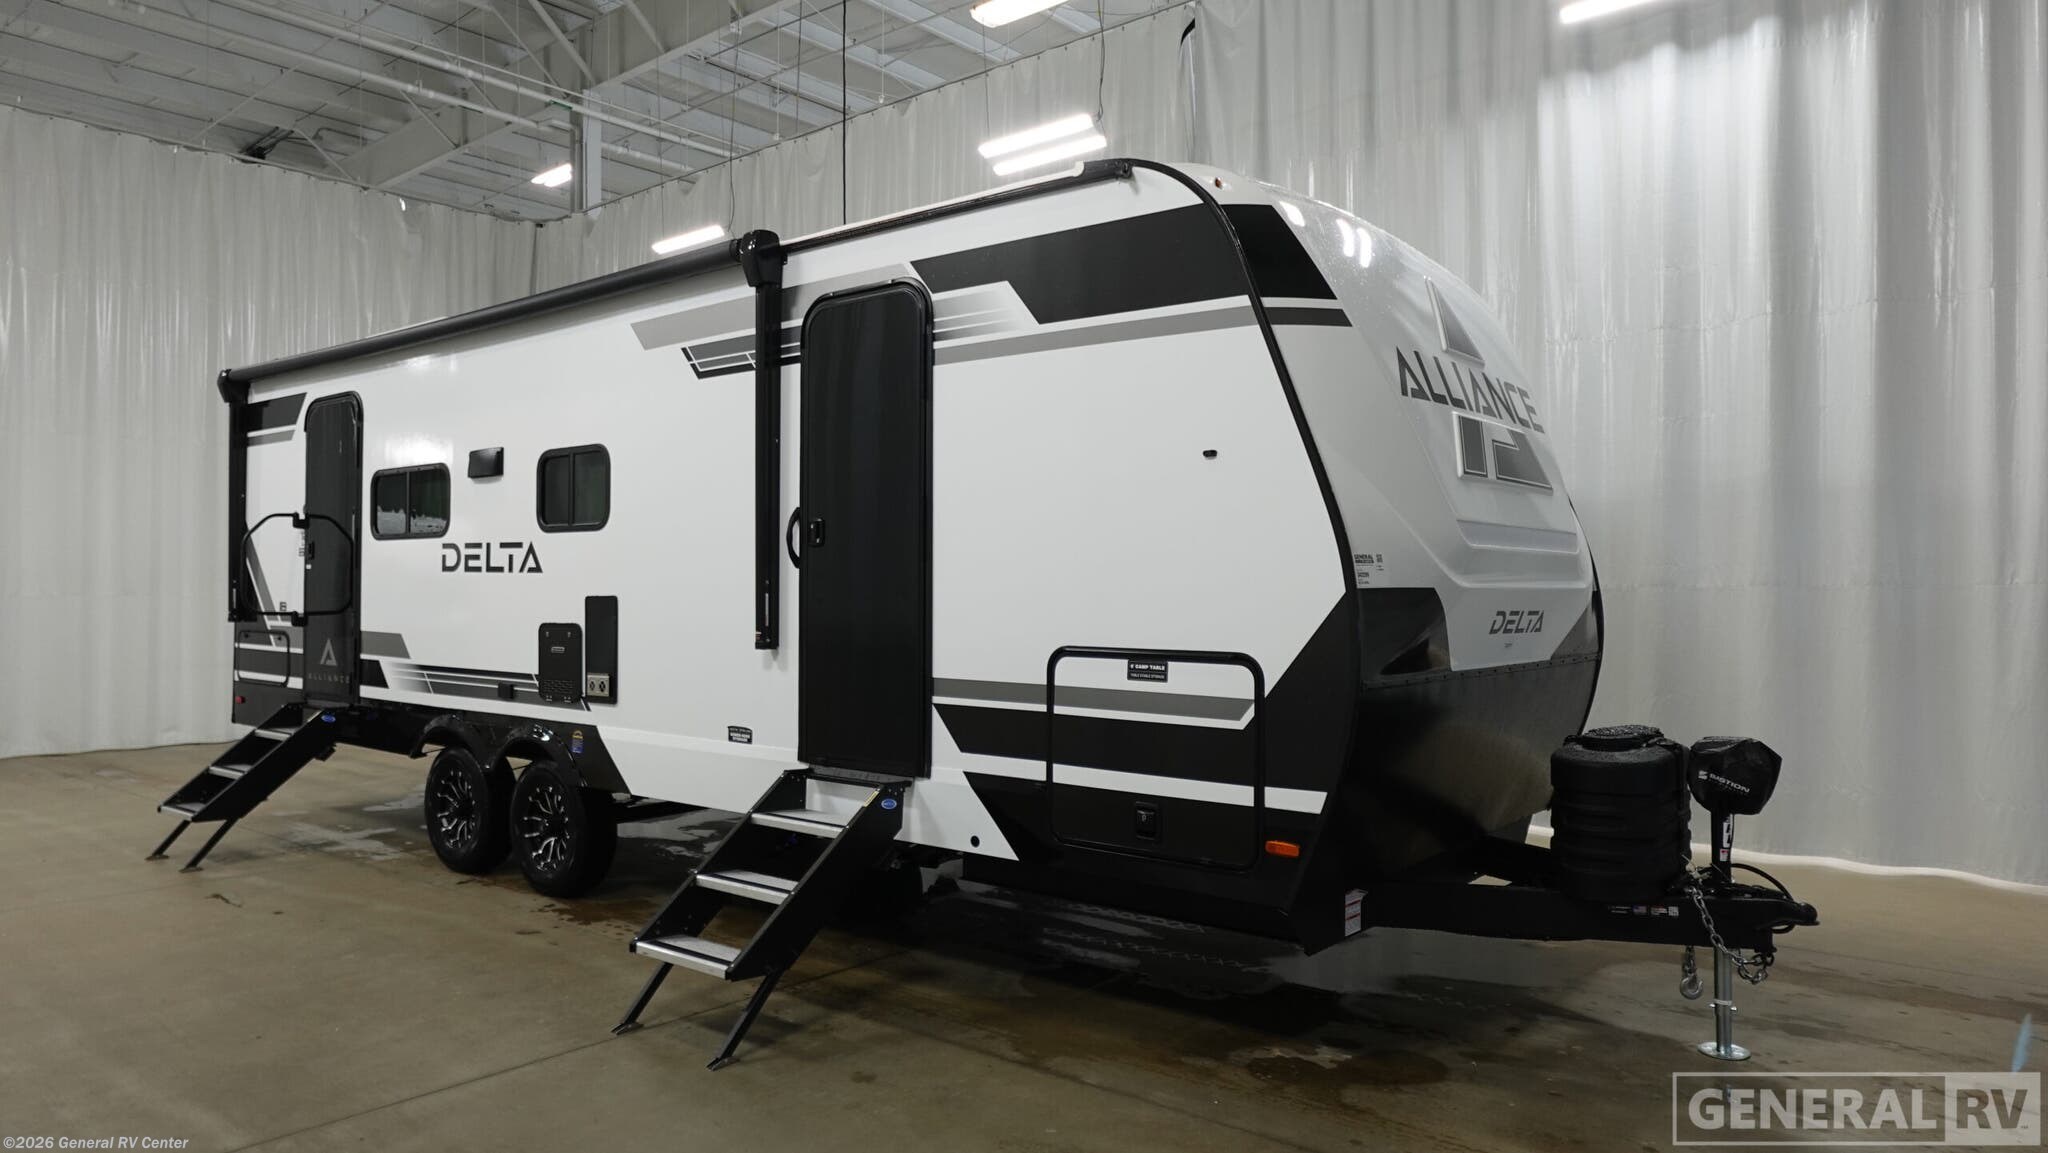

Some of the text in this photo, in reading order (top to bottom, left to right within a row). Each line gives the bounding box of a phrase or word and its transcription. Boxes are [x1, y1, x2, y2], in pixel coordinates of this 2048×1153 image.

[1396, 346, 1545, 434] ALLIANCE
[441, 541, 543, 573] DELTA
[1489, 610, 1545, 634] DELTA
[308, 671, 351, 684] ALLIANCE
[1709, 773, 1751, 793] BASTION
